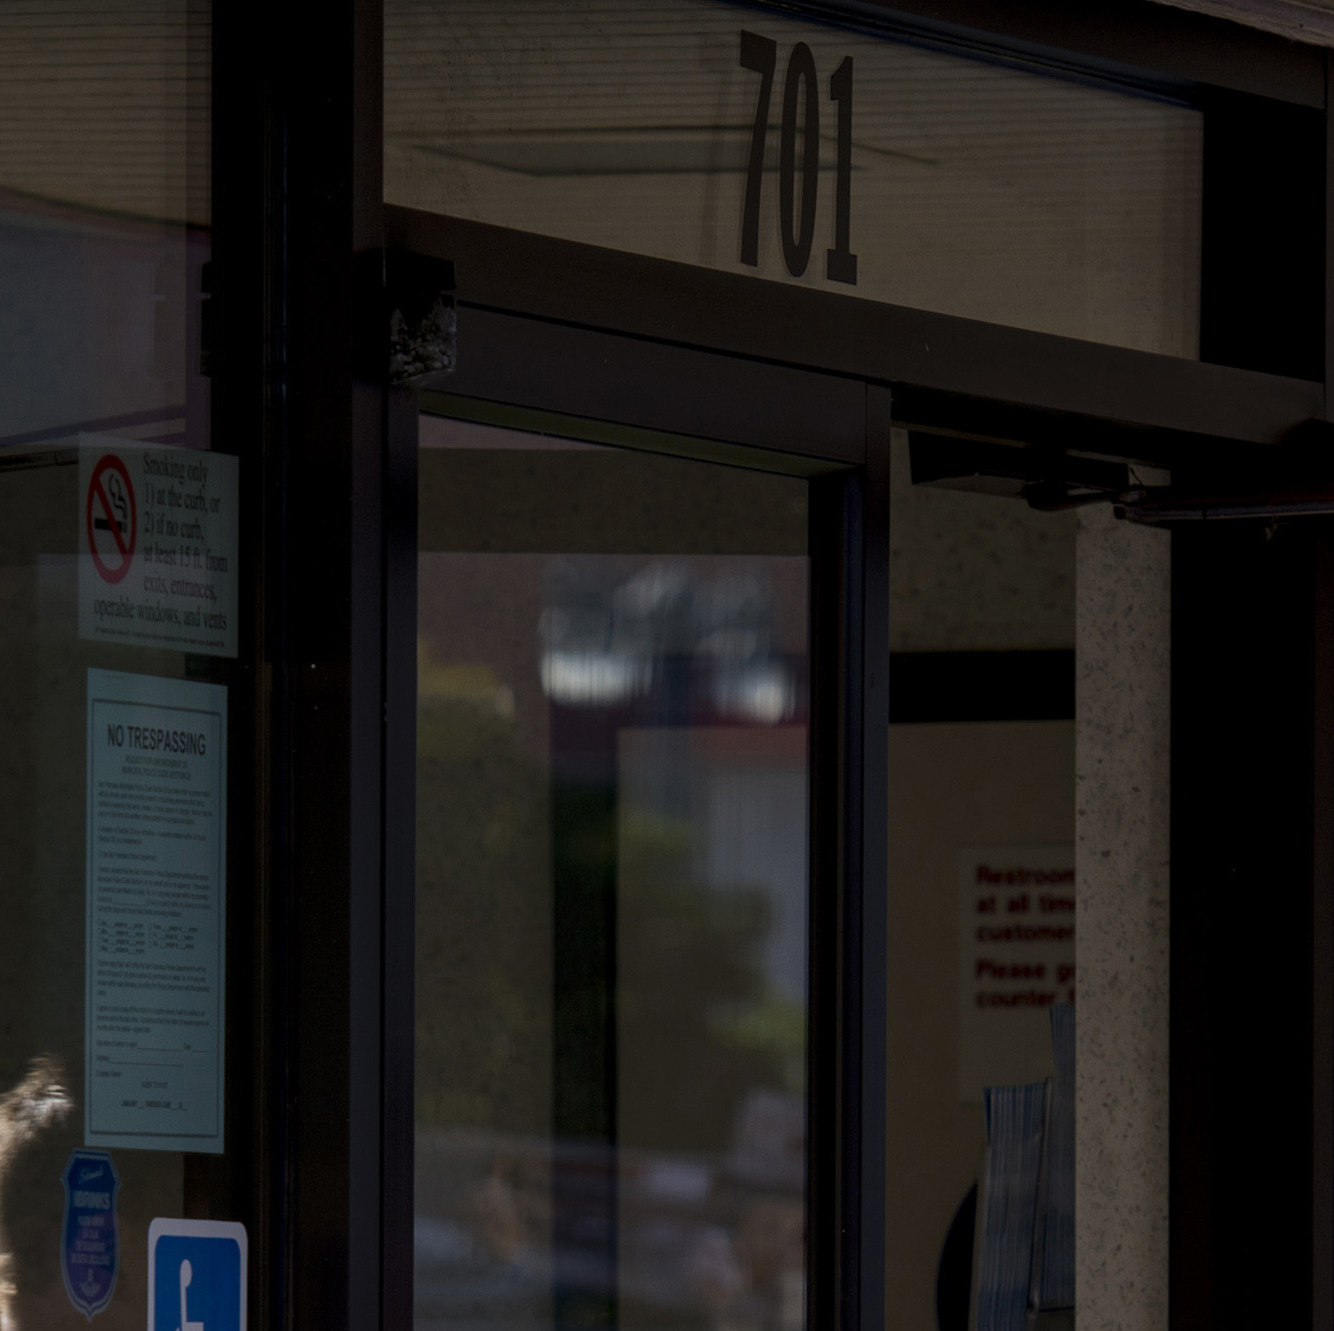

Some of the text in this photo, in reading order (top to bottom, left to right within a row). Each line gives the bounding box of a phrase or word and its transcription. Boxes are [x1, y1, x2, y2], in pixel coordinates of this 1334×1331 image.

[739, 30, 858, 286] 701
[143, 453, 208, 487] Smoking only
[156, 487, 166, 505] at
[167, 485, 182, 508] the
[184, 488, 207, 512] curb,
[210, 497, 220, 513] or
[144, 511, 204, 542] 2) if no curb,
[143, 546, 153, 561] at
[155, 542, 177, 565] least
[180, 546, 190, 567] 15
[206, 549, 228, 573] from
[171, 577, 216, 603] entrances,
[94, 596, 227, 630] operable windows, and vents
[108, 724, 207, 756] NO TRESPASSING
[977, 896, 995, 913] at
[1008, 894, 1028, 913] all
[975, 957, 1046, 979] Please
[976, 991, 1055, 1010] counter
